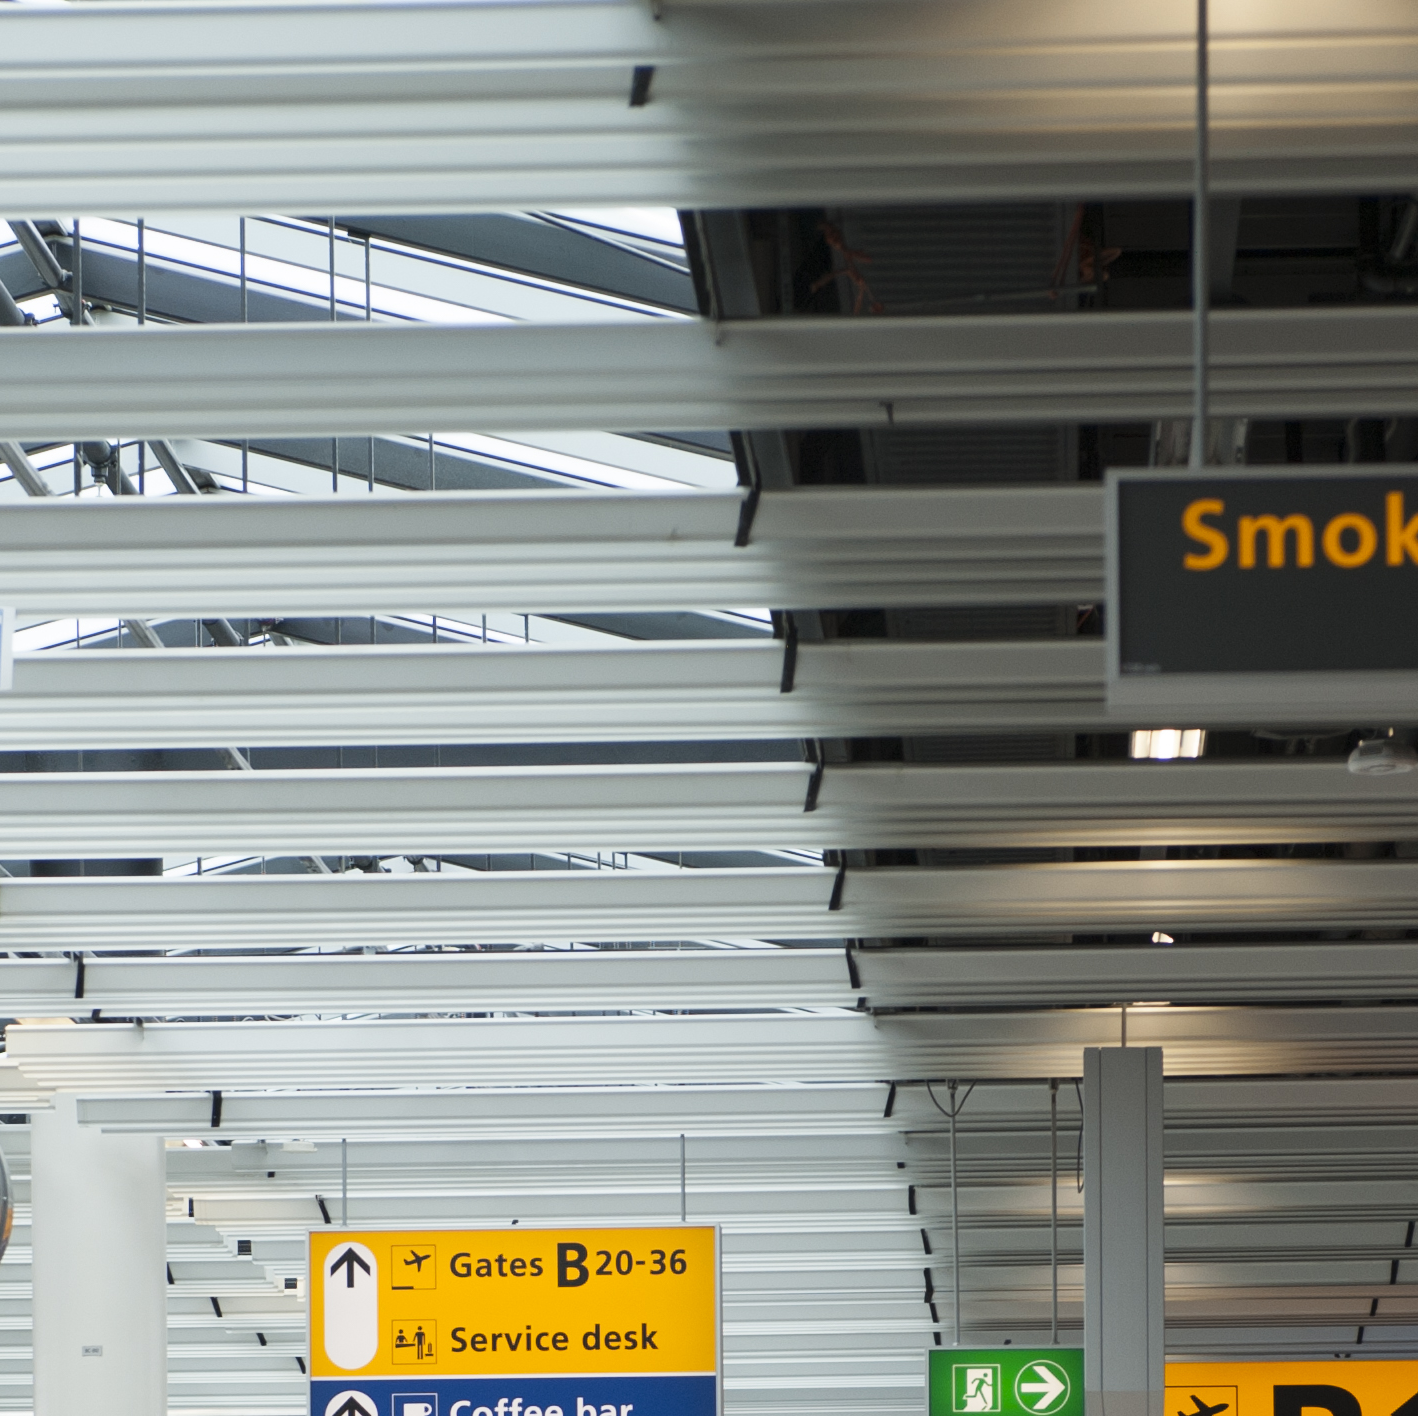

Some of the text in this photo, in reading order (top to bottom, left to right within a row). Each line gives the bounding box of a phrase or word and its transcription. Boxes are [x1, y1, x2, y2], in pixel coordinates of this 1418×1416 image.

[450, 1252, 543, 1278] Gates
[451, 1323, 659, 1352] Service desk
